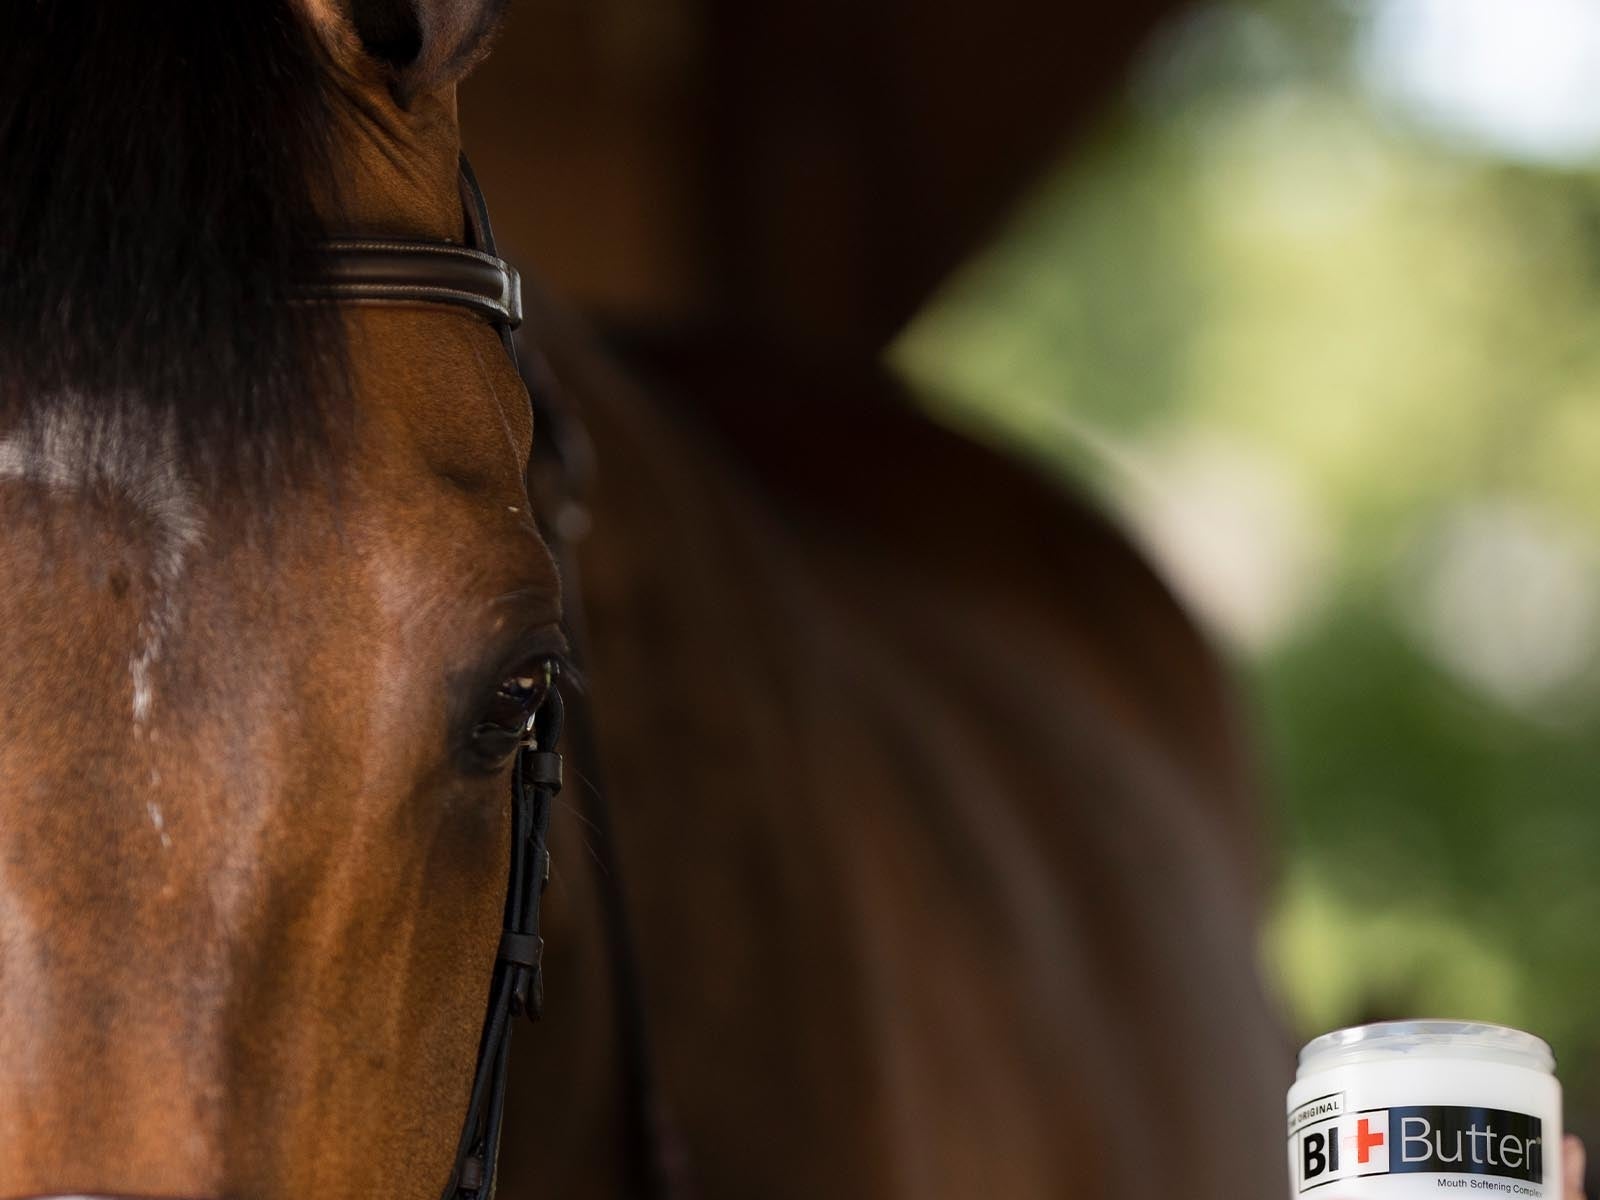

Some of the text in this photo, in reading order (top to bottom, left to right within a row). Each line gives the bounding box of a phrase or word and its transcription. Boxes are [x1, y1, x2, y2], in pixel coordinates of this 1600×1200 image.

[1298, 1101, 1340, 1122] ORIGINAL
[1401, 1117, 1537, 1170] Butter
[1437, 1178, 1543, 1198] Mouth Softening Complex
